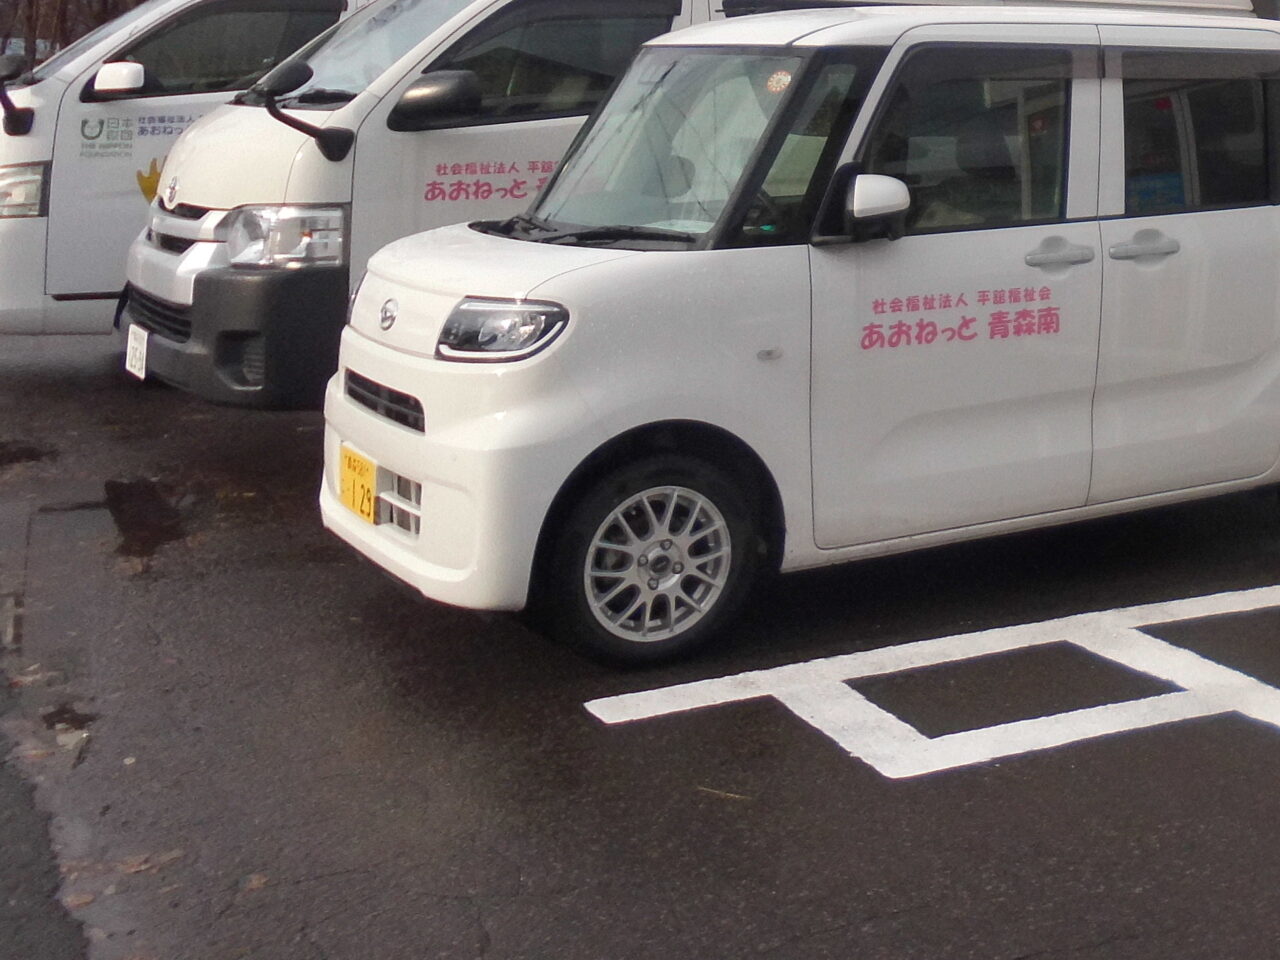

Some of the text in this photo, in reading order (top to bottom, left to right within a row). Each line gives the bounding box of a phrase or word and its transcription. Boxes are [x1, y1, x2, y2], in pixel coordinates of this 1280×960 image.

[424, 178, 528, 201] あおねっと
[872, 292, 969, 314] 社会福祉法人
[860, 306, 1061, 350] あおねっと 青森南
